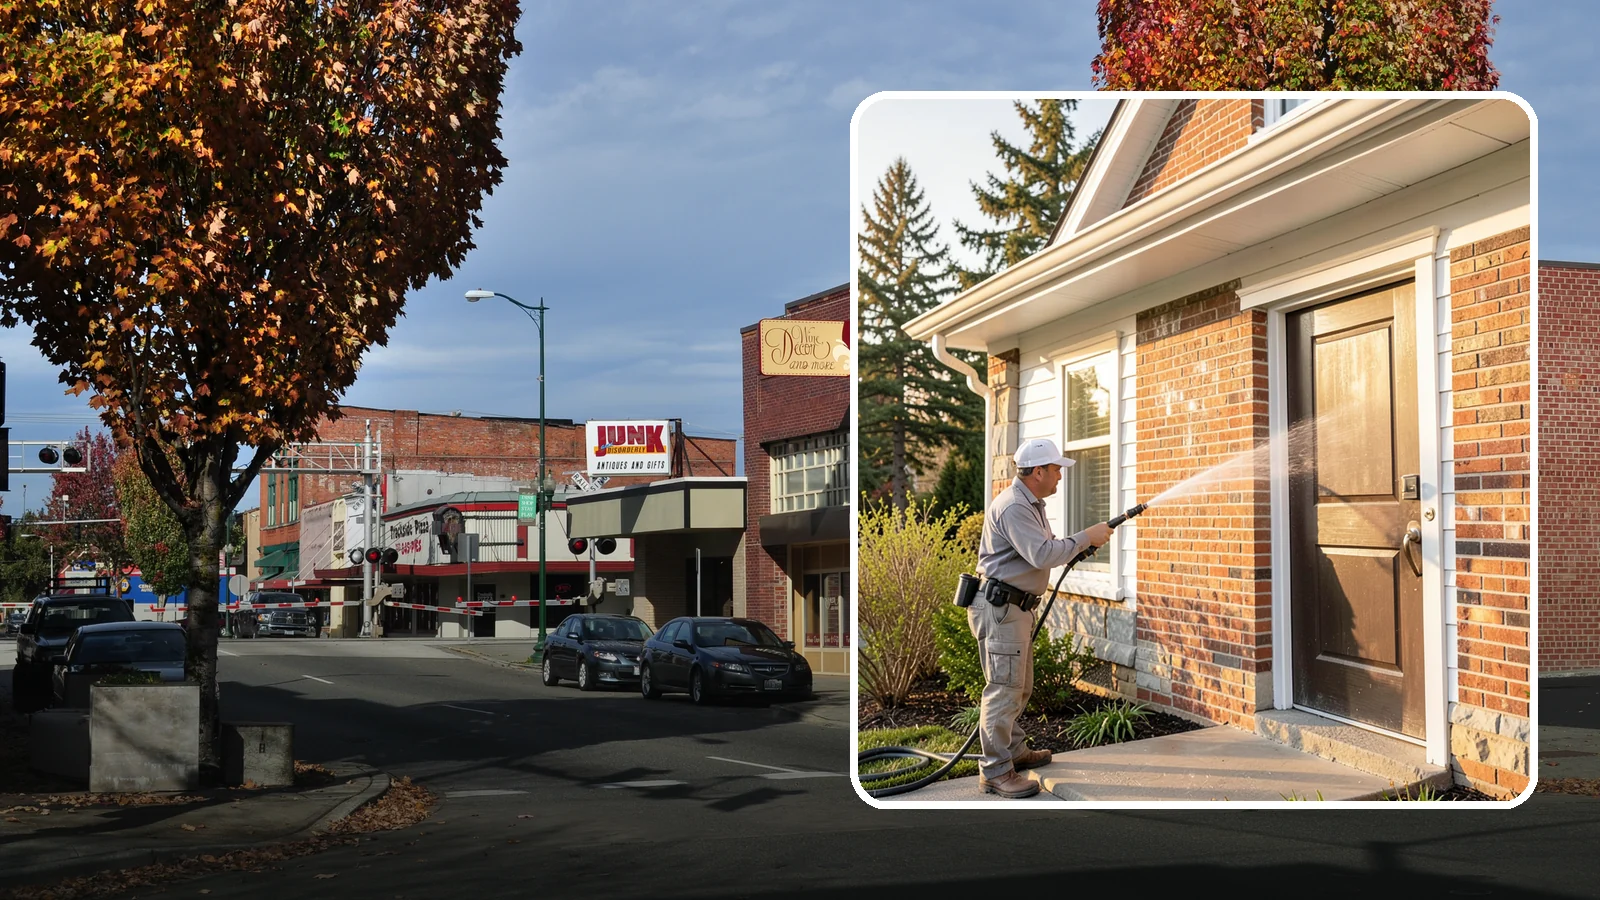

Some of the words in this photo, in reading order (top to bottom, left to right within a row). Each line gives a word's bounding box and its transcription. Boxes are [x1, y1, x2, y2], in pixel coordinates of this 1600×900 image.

[596, 425, 666, 457] JUNK
[607, 446, 646, 454] DISORDERLY
[597, 461, 628, 470] ANTIQUES
[631, 461, 644, 470] AND
[647, 461, 665, 470] GIFTS
[414, 519, 429, 535] Pizza
